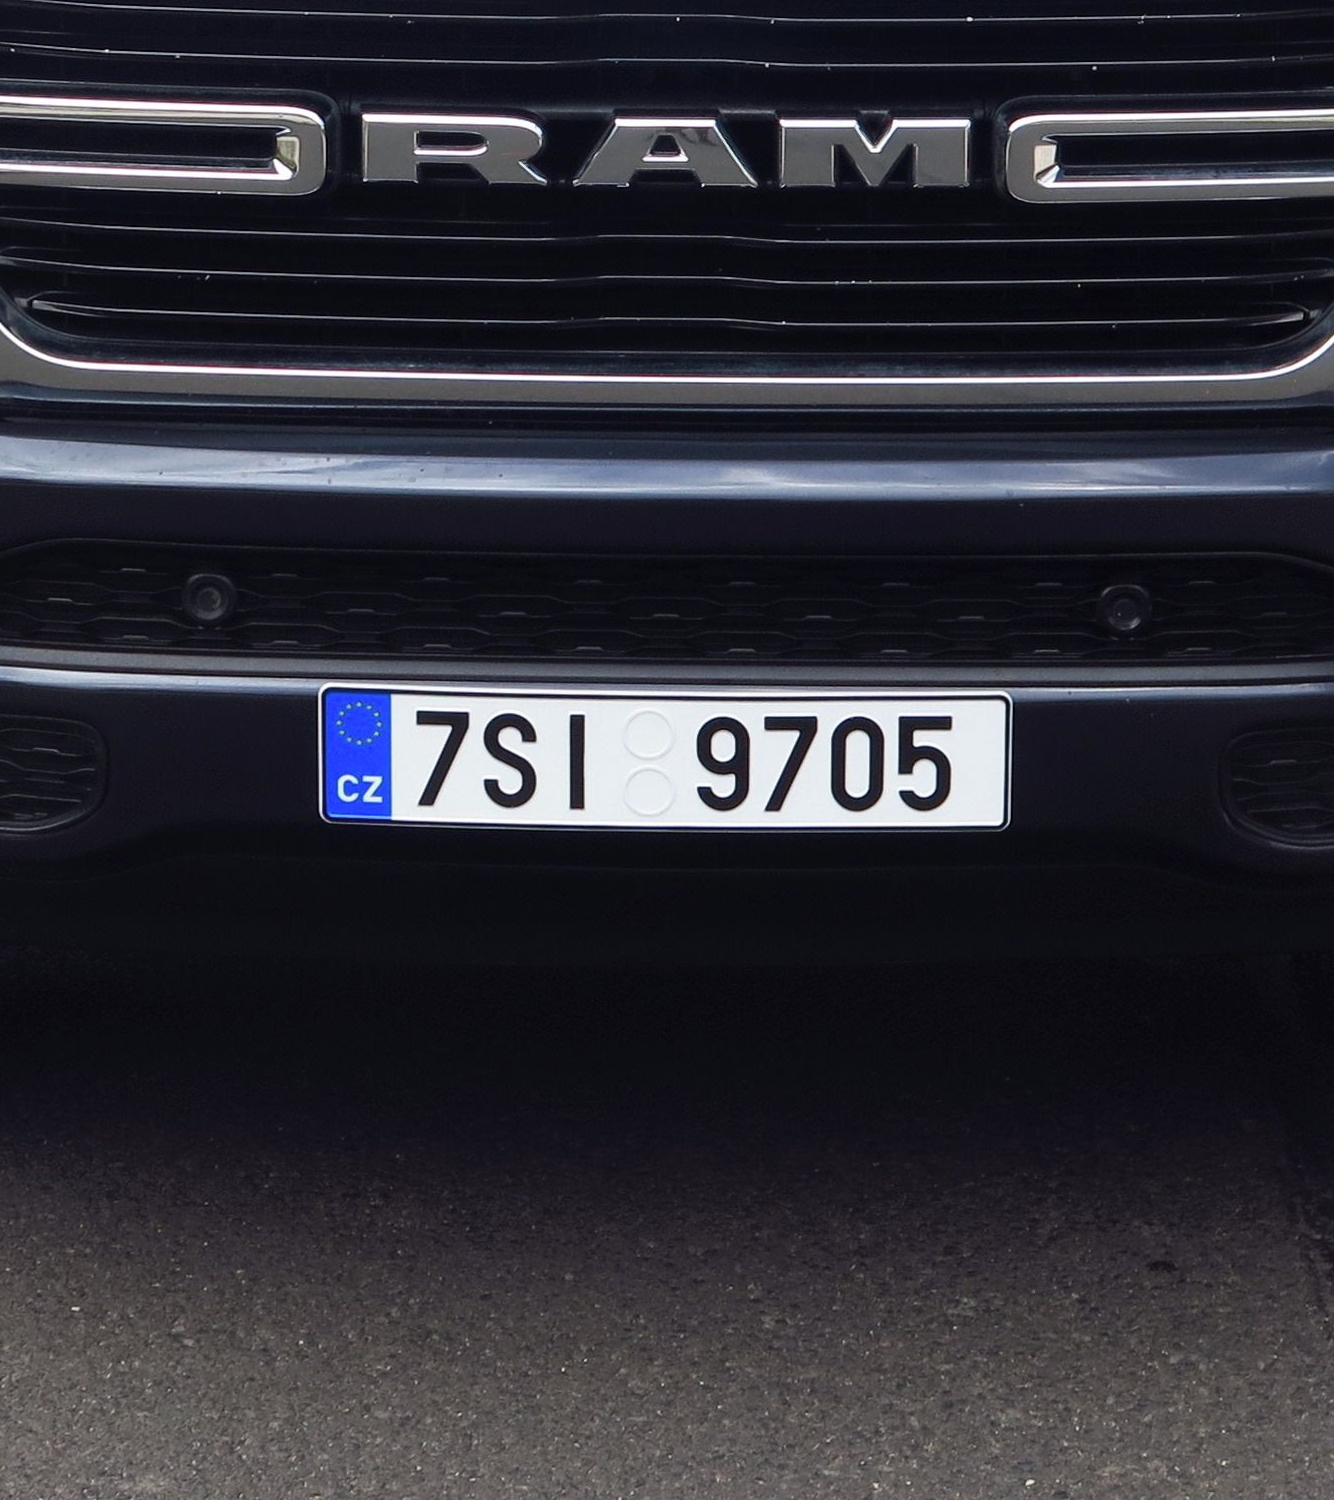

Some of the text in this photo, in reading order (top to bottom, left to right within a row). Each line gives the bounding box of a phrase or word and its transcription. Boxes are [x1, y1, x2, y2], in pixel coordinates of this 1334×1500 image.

[362, 112, 971, 188] RAM
[337, 774, 383, 803] CZ
[415, 710, 953, 812] 7SI 9705
